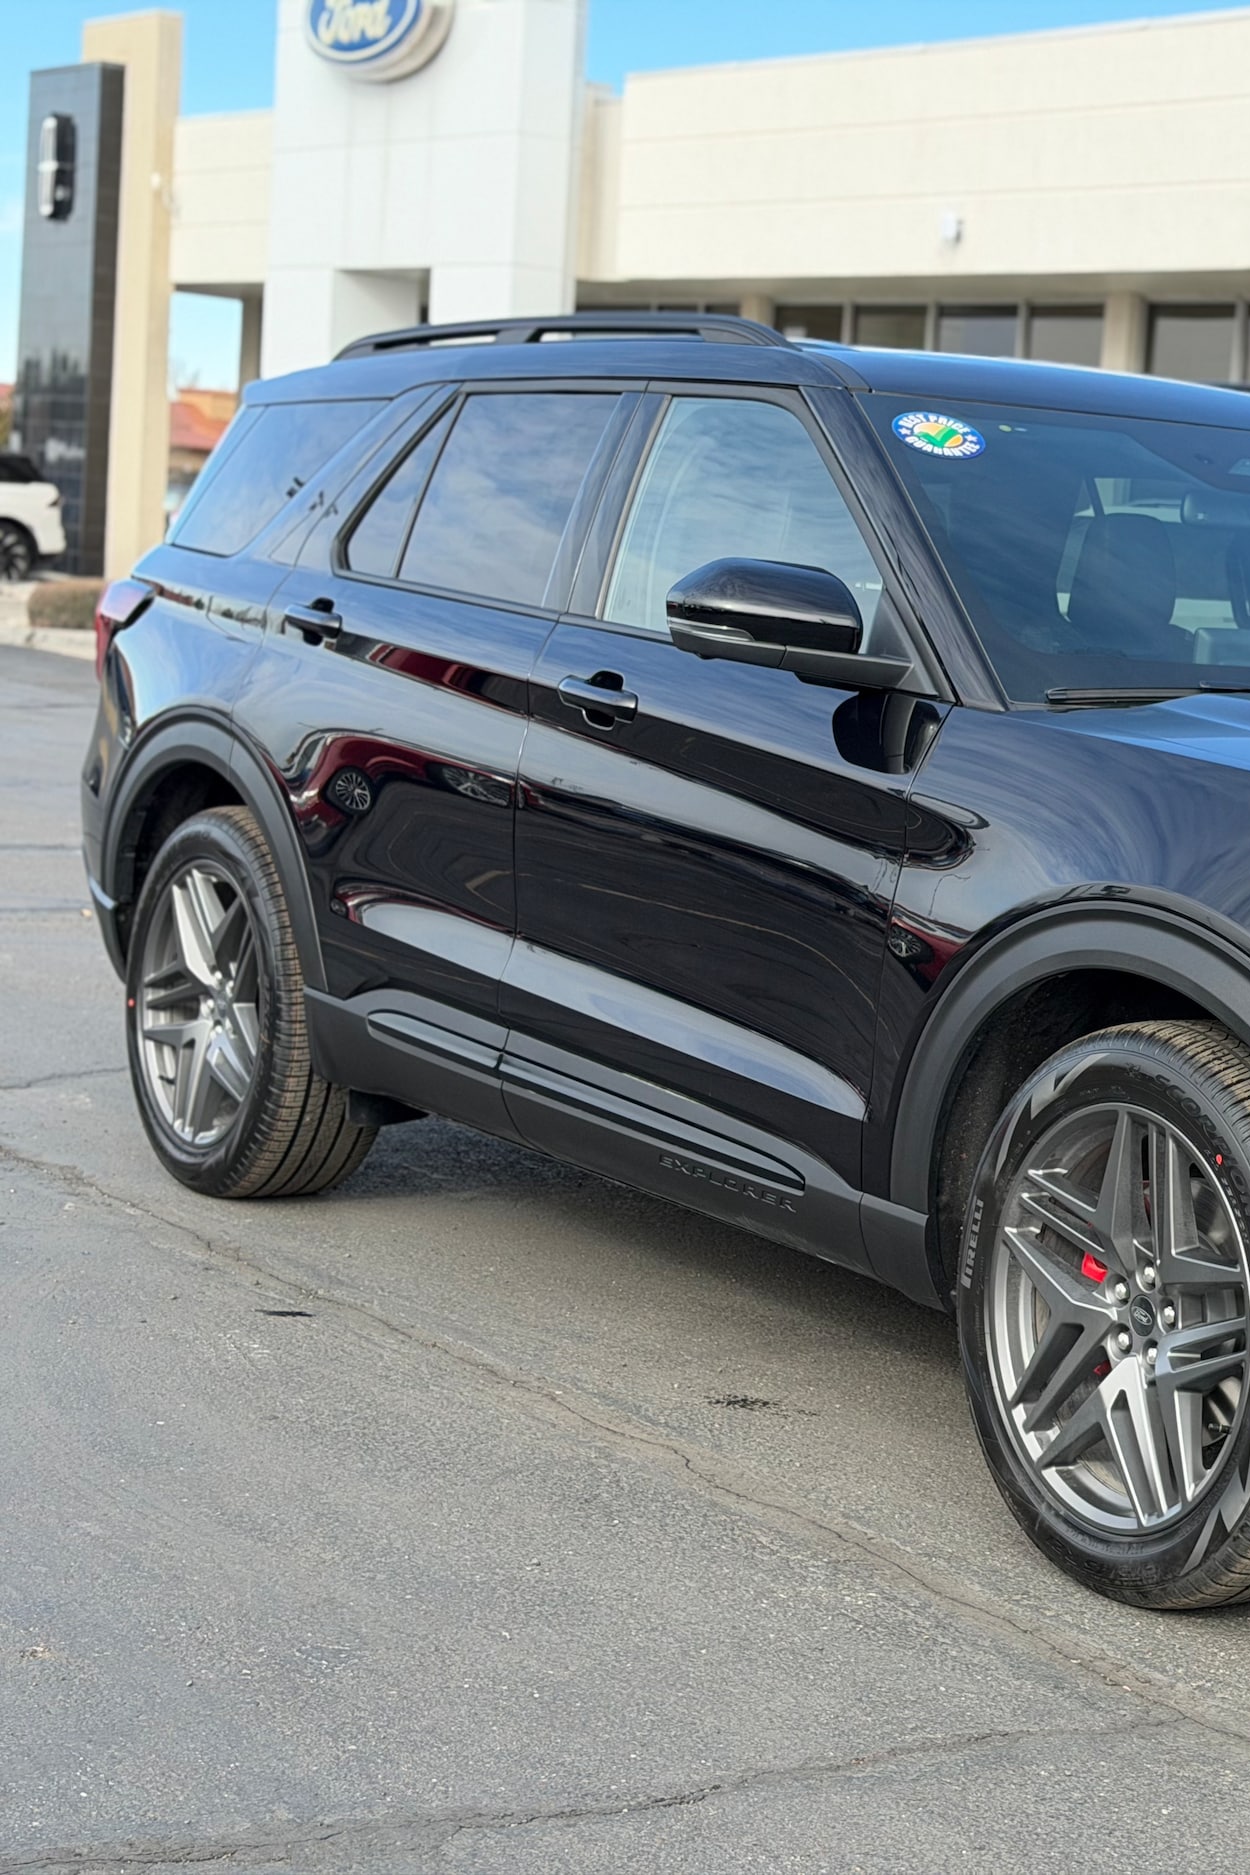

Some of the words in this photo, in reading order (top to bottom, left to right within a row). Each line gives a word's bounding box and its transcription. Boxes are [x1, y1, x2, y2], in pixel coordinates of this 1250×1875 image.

[317, 0, 392, 45] Ford
[898, 413, 927, 428] BEST
[927, 414, 971, 434] PRICE
[904, 435, 980, 457] GUARANTEE
[658, 1154, 797, 1214] EXPLORER
[960, 1196, 984, 1289] PIRELLI
